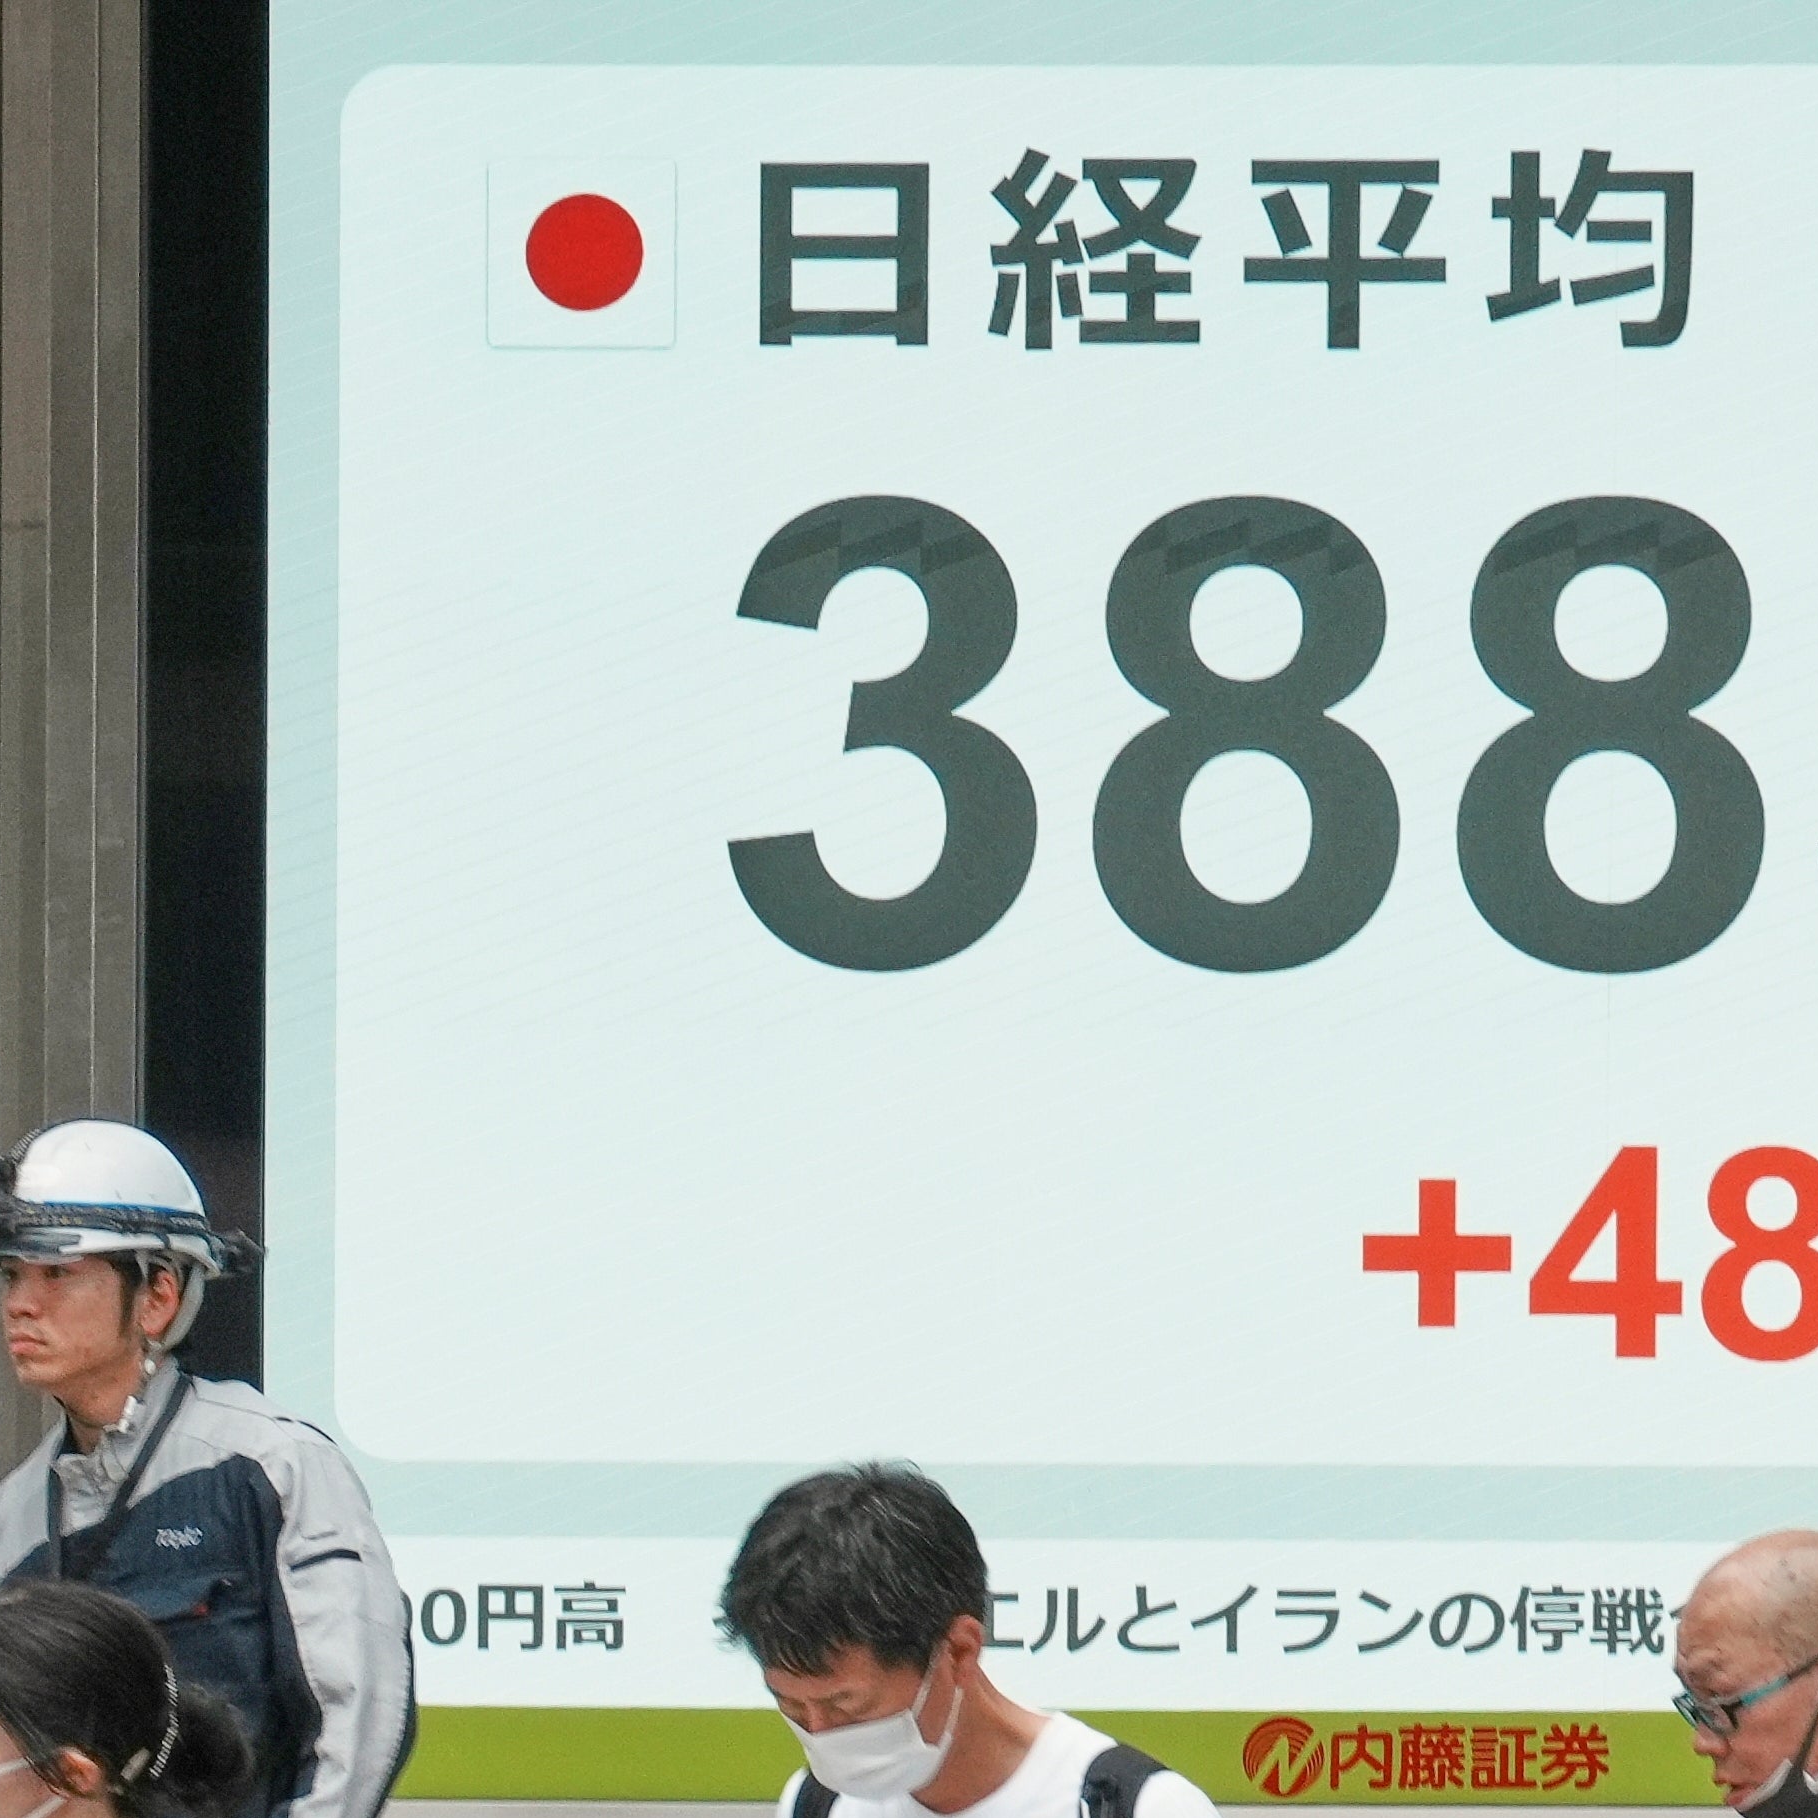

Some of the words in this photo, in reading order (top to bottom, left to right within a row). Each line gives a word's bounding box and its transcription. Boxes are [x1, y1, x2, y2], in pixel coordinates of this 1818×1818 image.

[758, 147, 1697, 352] 日経平均
[399, 1580, 627, 1652] 0円高
[982, 1584, 1687, 1658] エルとイランの停戦
[1330, 1724, 1611, 1790] 内藤証券
